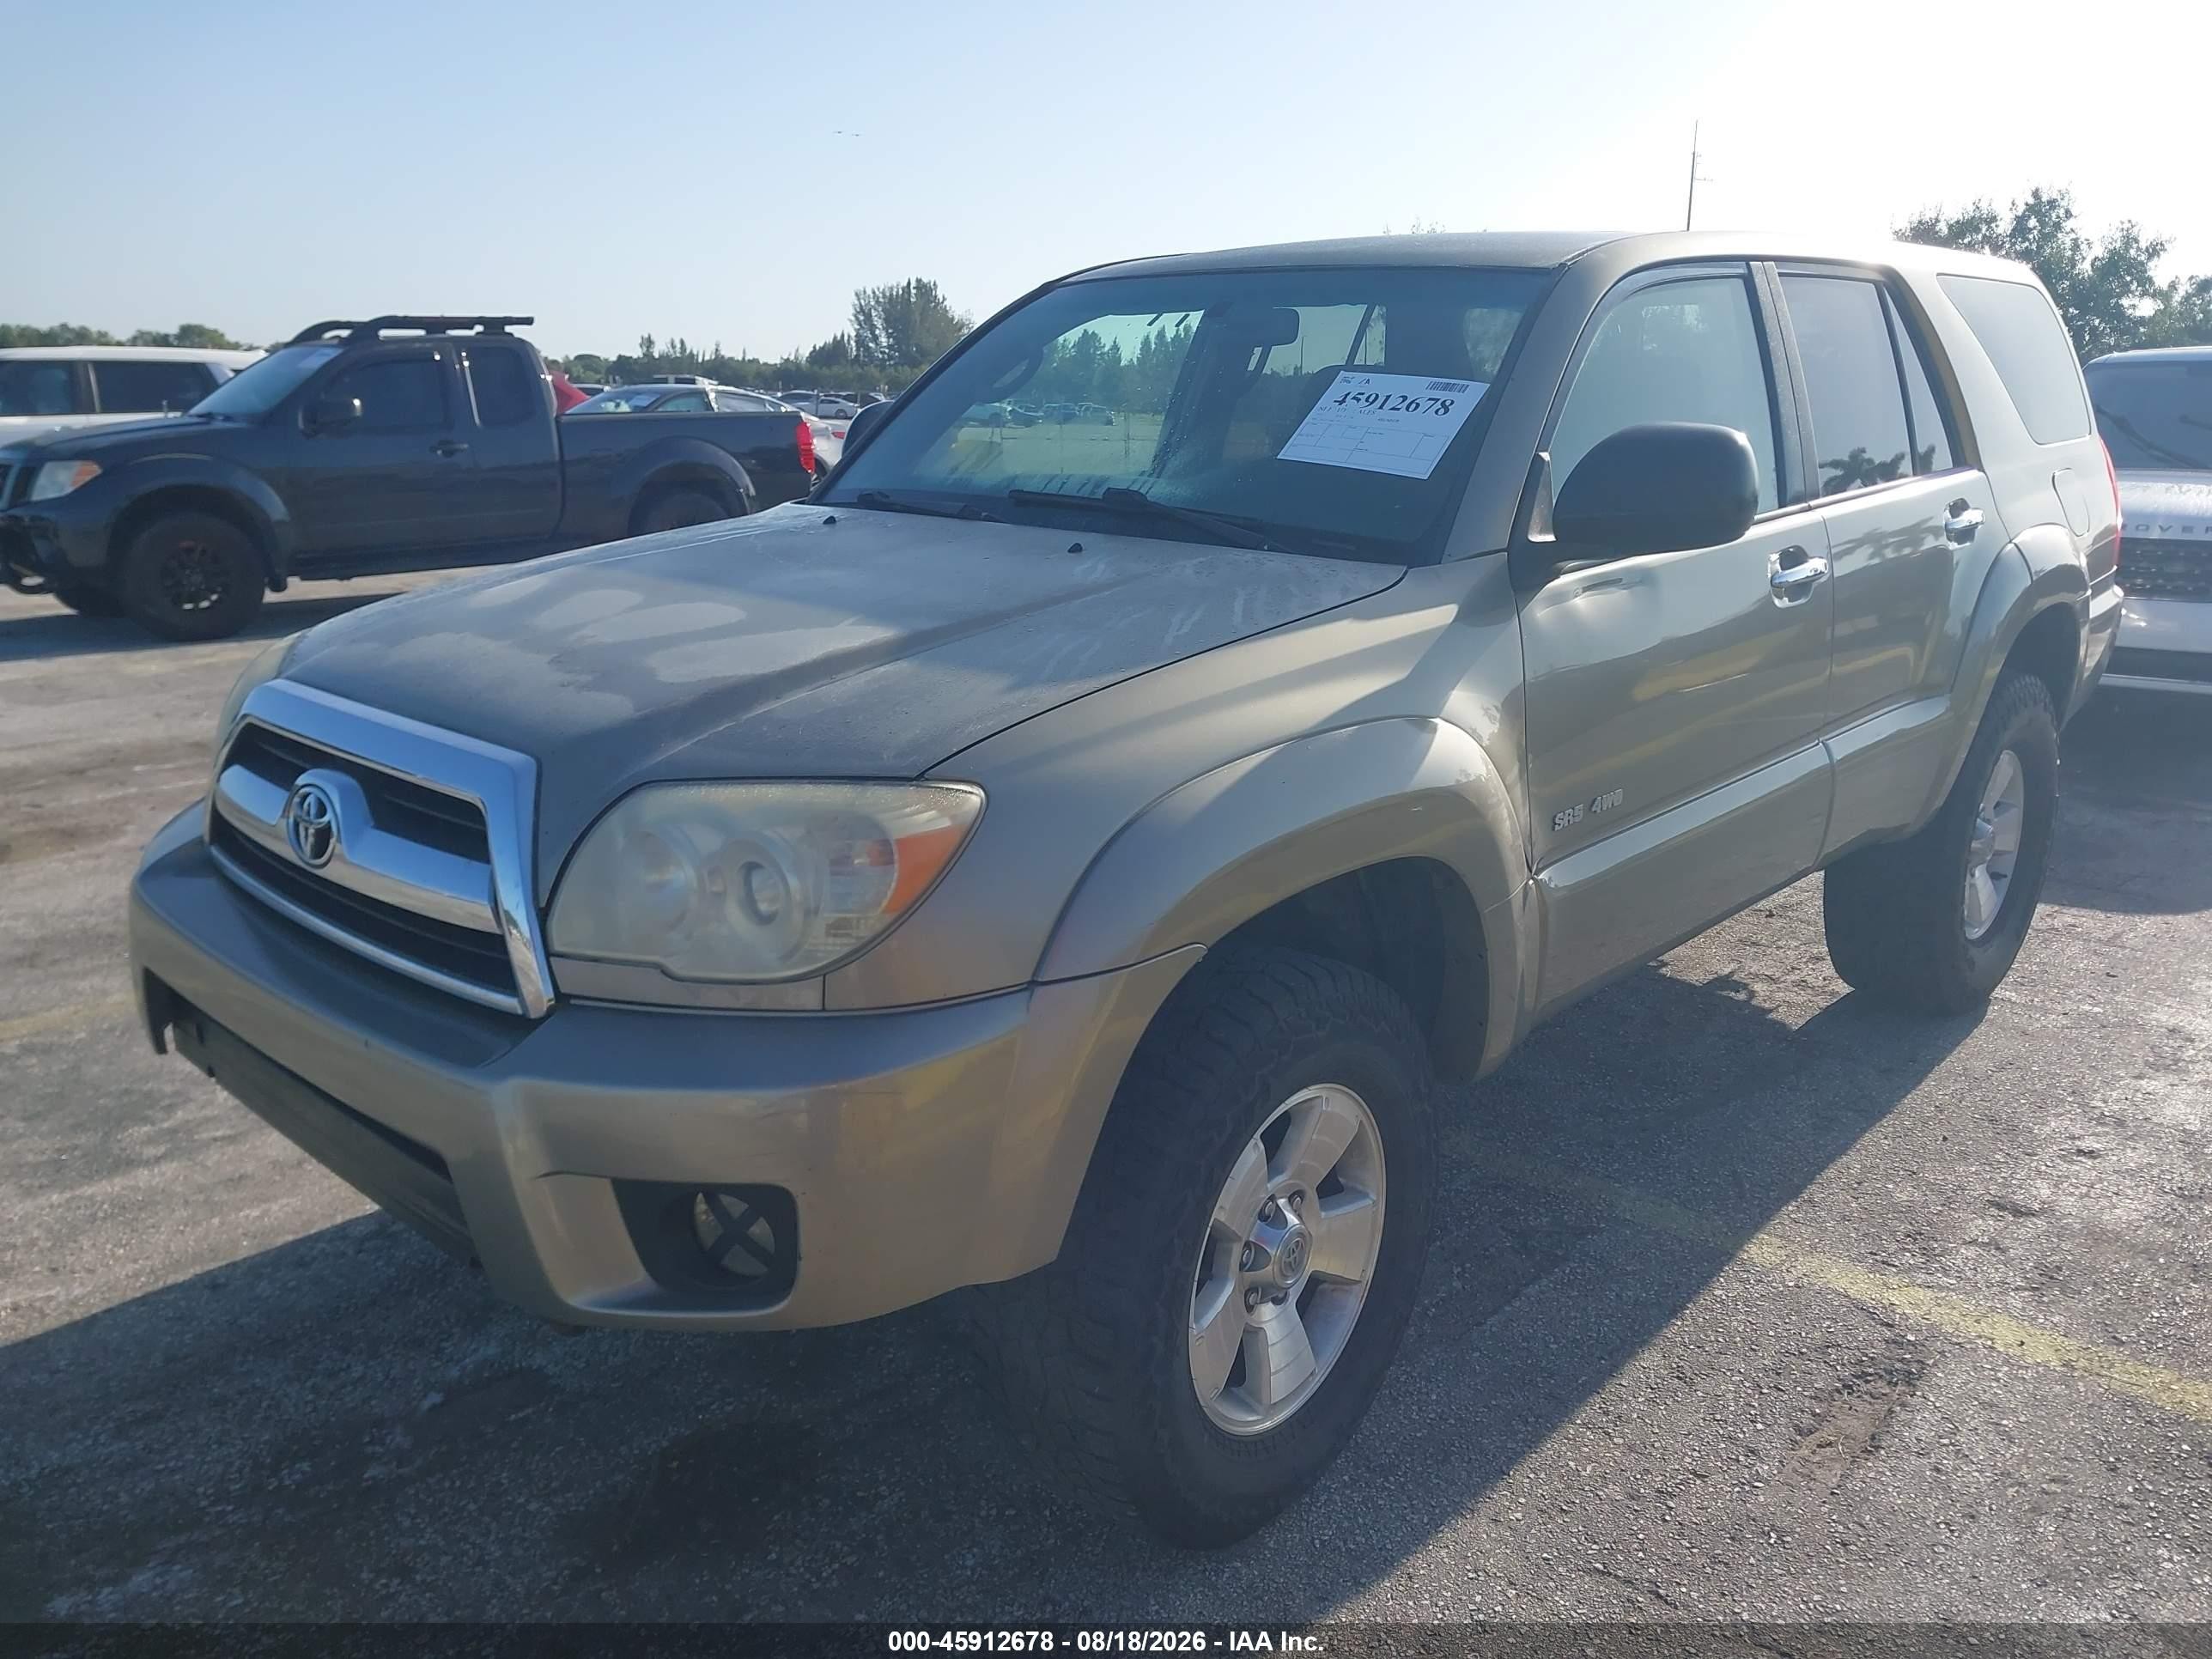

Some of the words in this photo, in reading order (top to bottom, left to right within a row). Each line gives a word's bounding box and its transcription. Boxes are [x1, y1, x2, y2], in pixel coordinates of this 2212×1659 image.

[1333, 391, 1455, 416] 45912678
[1553, 804, 1583, 831] SR5
[1591, 788, 1623, 813] 4WD
